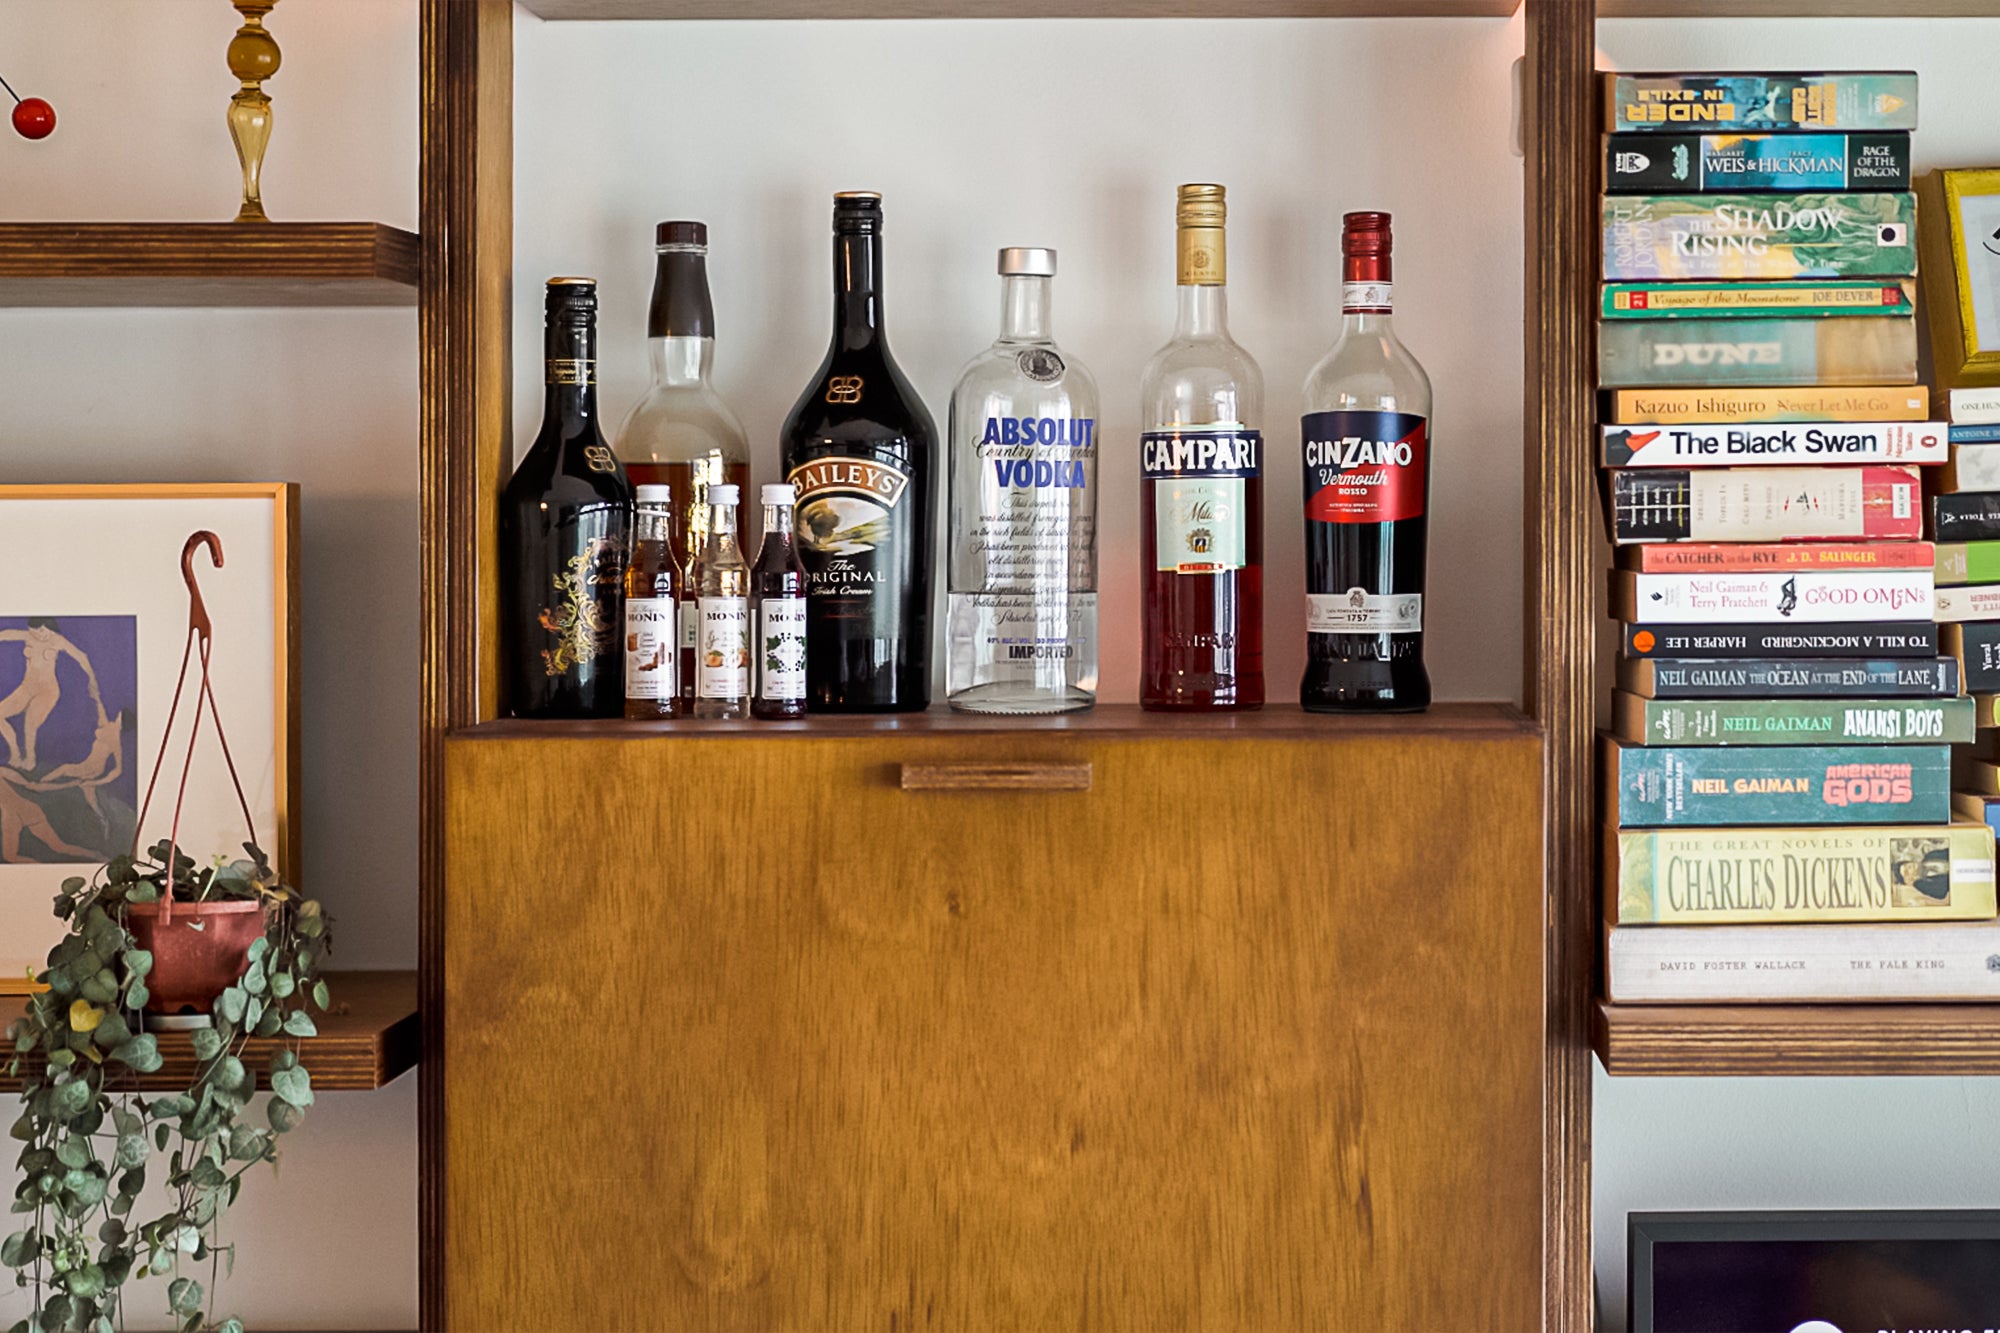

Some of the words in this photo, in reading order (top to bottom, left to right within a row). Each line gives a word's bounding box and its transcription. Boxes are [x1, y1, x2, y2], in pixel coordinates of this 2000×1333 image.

[1638, 89, 1694, 101] EXILE
[1703, 90, 1724, 101] IN
[1626, 103, 1735, 122] ENDER
[1862, 146, 1890, 157] RAGE
[1706, 157, 1745, 173] WEIS
[1746, 159, 1757, 171] &
[1759, 157, 1843, 175] HICKMAN
[1857, 156, 1872, 167] OF
[1873, 156, 1895, 167] THE
[1853, 166, 1900, 178] DRAGON
[1689, 221, 1711, 232] THE
[1715, 204, 1844, 231] SHADOW
[1614, 205, 1632, 267] ROBERT
[1635, 204, 1661, 271] JORDAN
[1670, 230, 1767, 257] RISING
[1633, 293, 1645, 306] 21
[1653, 293, 1691, 306] Voyage
[1693, 292, 1710, 305] of
[1713, 292, 1732, 303] the
[1737, 292, 1800, 303] Moonstone
[1812, 291, 1832, 303] JOE
[1835, 290, 1873, 302] DEVER
[1654, 343, 1782, 365] DUNE
[1634, 399, 1689, 414] Kazuo
[1696, 397, 1766, 416] Ishiguro
[1776, 399, 1817, 413] Never
[1819, 399, 1840, 412] Let
[1842, 399, 1866, 412] Me
[1868, 399, 1888, 412] Go
[983, 417, 1095, 447] ABSOLUT
[1951, 430, 1990, 438] ANTOINE
[971, 435, 1034, 463] Country
[1669, 431, 1718, 454] The
[1727, 430, 1795, 454] Black
[1805, 430, 1876, 453] Swan
[1143, 438, 1256, 472] CAMPARI
[1306, 437, 1412, 469] CINZANO
[792, 464, 896, 496] BAILEYS
[994, 460, 1085, 488] VODKA
[1319, 468, 1388, 487] Vermouth
[1338, 487, 1368, 496] ROSSO
[1666, 552, 1724, 564] CATCHER
[1737, 553, 1751, 563] the
[1752, 552, 1779, 563] RYE
[1787, 551, 1797, 563] J.
[1801, 551, 1812, 562] D.
[1819, 551, 1876, 563] SALINGER
[827, 559, 856, 571] The
[812, 586, 836, 596] Irish
[839, 585, 873, 596] Cream
[1690, 580, 1713, 593] Neil
[1716, 580, 1757, 593] Gaiman
[1759, 580, 1768, 593] &
[1690, 595, 1718, 612] Terry
[1721, 595, 1768, 608] Pratchett
[628, 612, 666, 622] MONIN
[769, 613, 807, 623] MOIN
[1347, 614, 1368, 622] 1757
[1665, 637, 1689, 648] LEE
[1694, 637, 1746, 648] HARPER
[1761, 636, 1859, 648] MOCKINGBIRD
[1863, 637, 1873, 647] A
[1876, 636, 1905, 648] KILL
[1909, 637, 1929, 647] TO
[1009, 646, 1073, 659] IMPORTED
[1981, 643, 1993, 671] Yuval
[1660, 670, 1688, 686] NEIL
[1691, 670, 1746, 686] GAIMAN
[1750, 673, 1766, 684] THE
[1767, 669, 1809, 686] OCEAN
[1811, 673, 1823, 684] AT
[1824, 673, 1841, 684] THE
[1843, 670, 1866, 685] END
[1868, 674, 1879, 684] OF
[1880, 674, 1897, 684] THE
[1898, 669, 1930, 685] LANE
[1723, 718, 1760, 732] NEIL
[1765, 717, 1832, 732] GAIMAN
[1844, 710, 1901, 737] ANANSI
[1905, 709, 1943, 737] BOYS
[1826, 763, 1912, 780] AMERICAN
[1675, 762, 1683, 810] BESTSELLER
[1692, 778, 1729, 794] NEIL
[1734, 777, 1810, 793] GAIMAN
[1822, 778, 1912, 806] GODS
[1667, 841, 1703, 851] THE
[1713, 840, 1771, 850] GREAT
[1782, 839, 1853, 850] NOVELS
[1863, 838, 1886, 849] OF
[1668, 855, 1776, 912] CHARLES
[1783, 854, 1886, 909] DICKENS
[1660, 961, 1696, 971] DAVID
[1704, 960, 1747, 970] FOSTER
[1755, 960, 1806, 970] WALLACE
[1850, 960, 1872, 970] THE
[1879, 959, 1908, 970] PALE
[1916, 959, 1945, 969] KING
